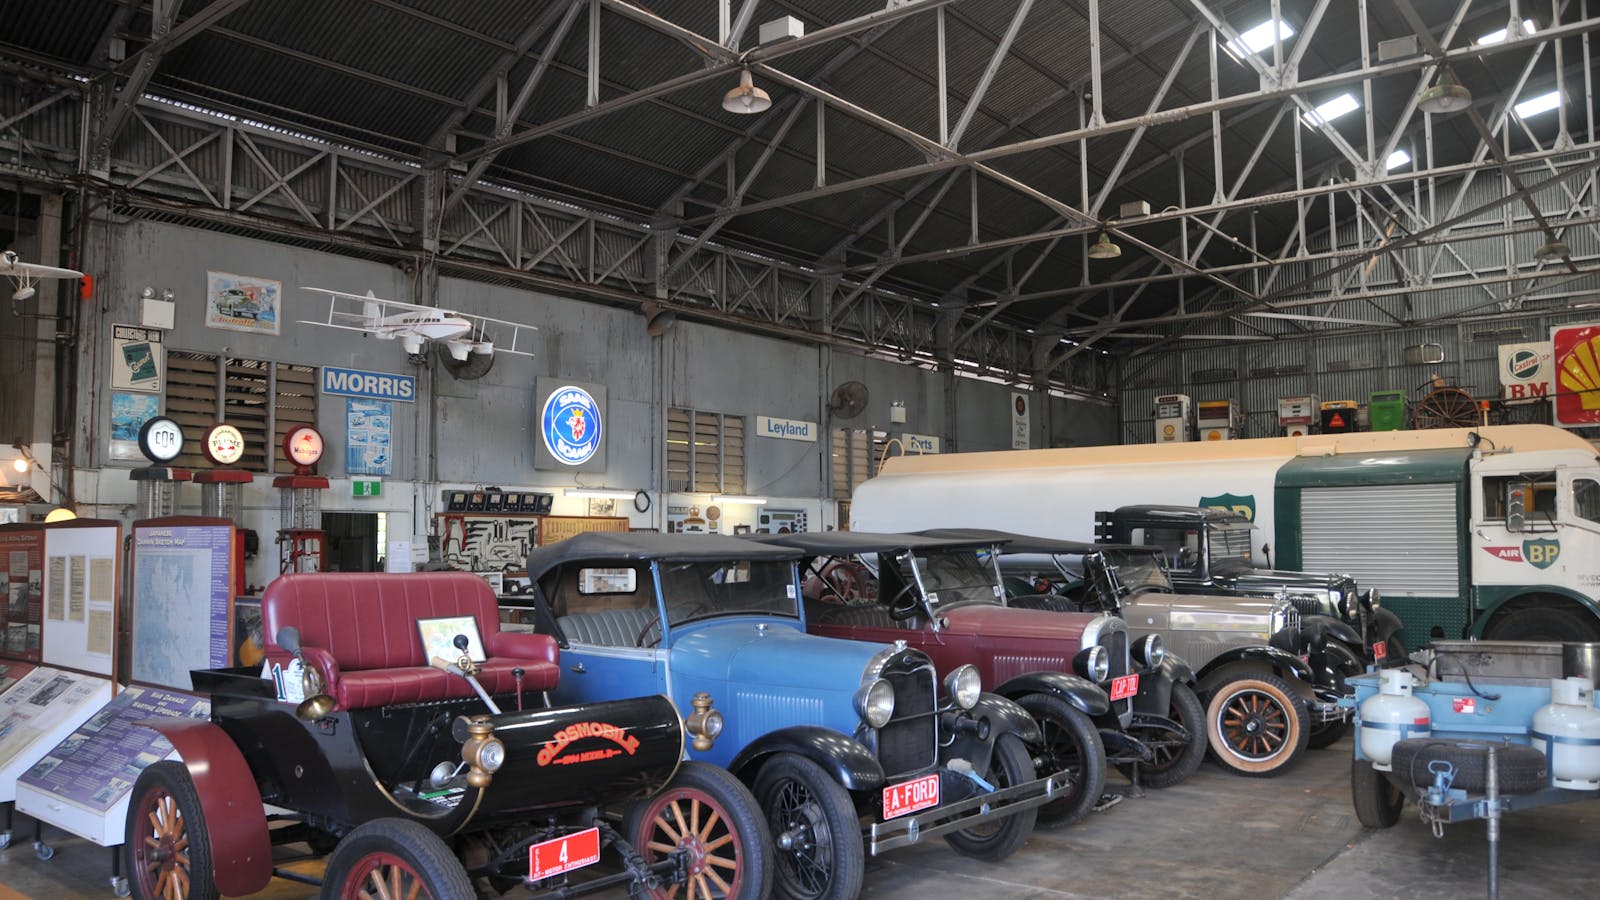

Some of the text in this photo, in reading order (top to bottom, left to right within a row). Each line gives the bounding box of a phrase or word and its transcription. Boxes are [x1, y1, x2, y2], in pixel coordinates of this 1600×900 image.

[1514, 356, 1538, 372] Castrol
[326, 371, 412, 397] MORRIS
[558, 392, 590, 409] SAAB
[767, 419, 808, 437] Leyland
[155, 430, 175, 448] COR
[212, 438, 241, 448] PLUME
[1498, 545, 1558, 563] AIR BP
[273, 664, 287, 701] 1
[537, 721, 640, 767] OLDSMOBILE
[559, 840, 568, 864] 4
